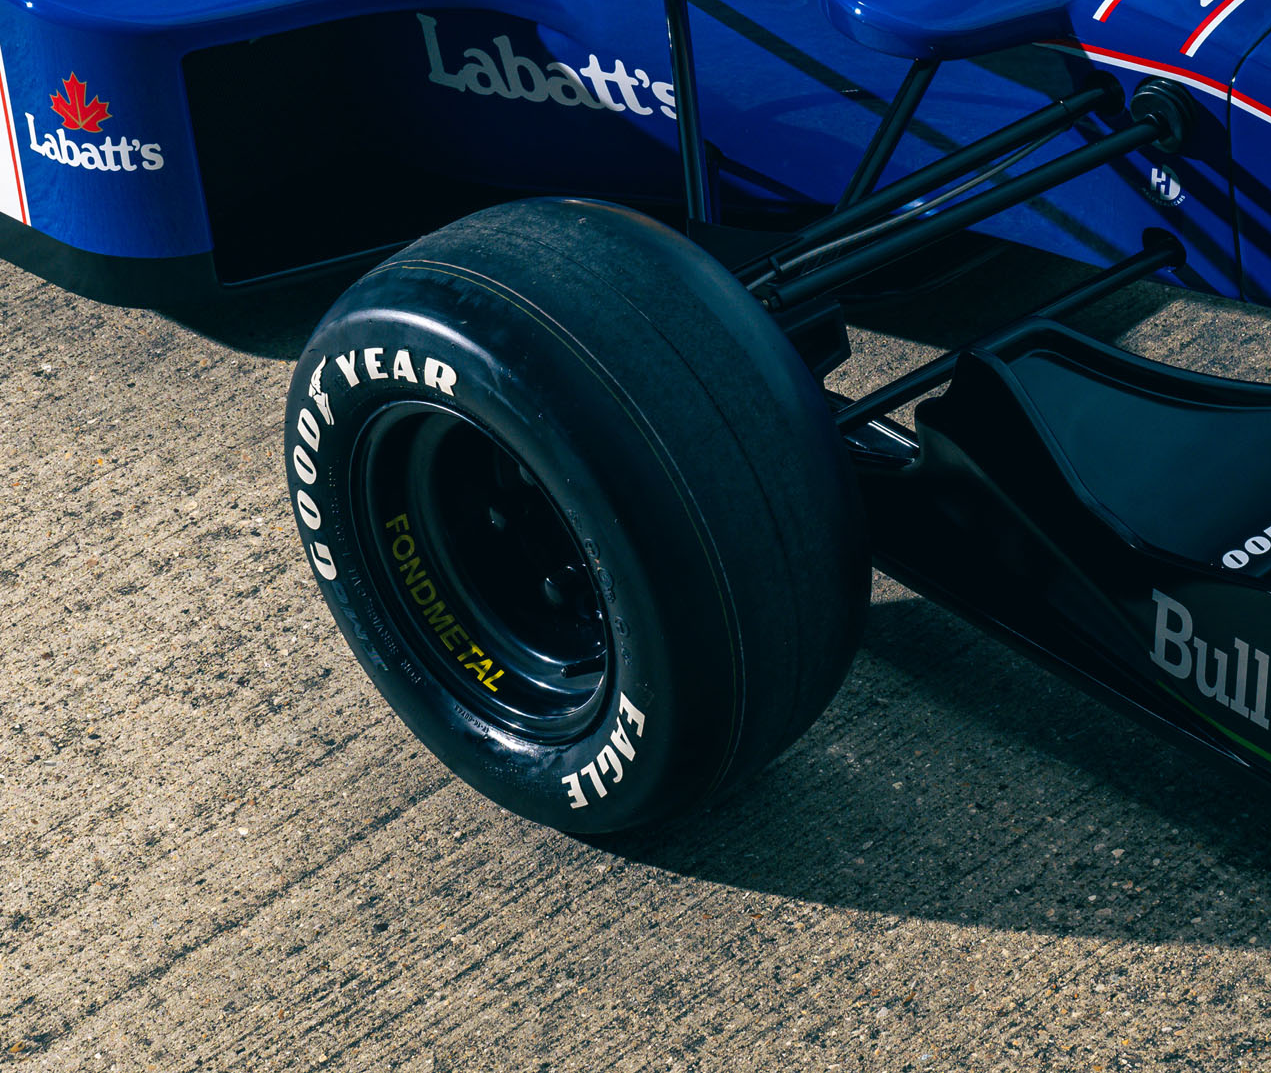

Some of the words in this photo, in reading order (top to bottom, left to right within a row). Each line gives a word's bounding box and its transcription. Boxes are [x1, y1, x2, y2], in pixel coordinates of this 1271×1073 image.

[416, 12, 677, 120] Labatt's
[24, 112, 165, 172] Labatt's
[385, 512, 508, 693] FONDMETAL
[1150, 587, 1270, 731] Bull
[561, 691, 646, 809] EAGLE
